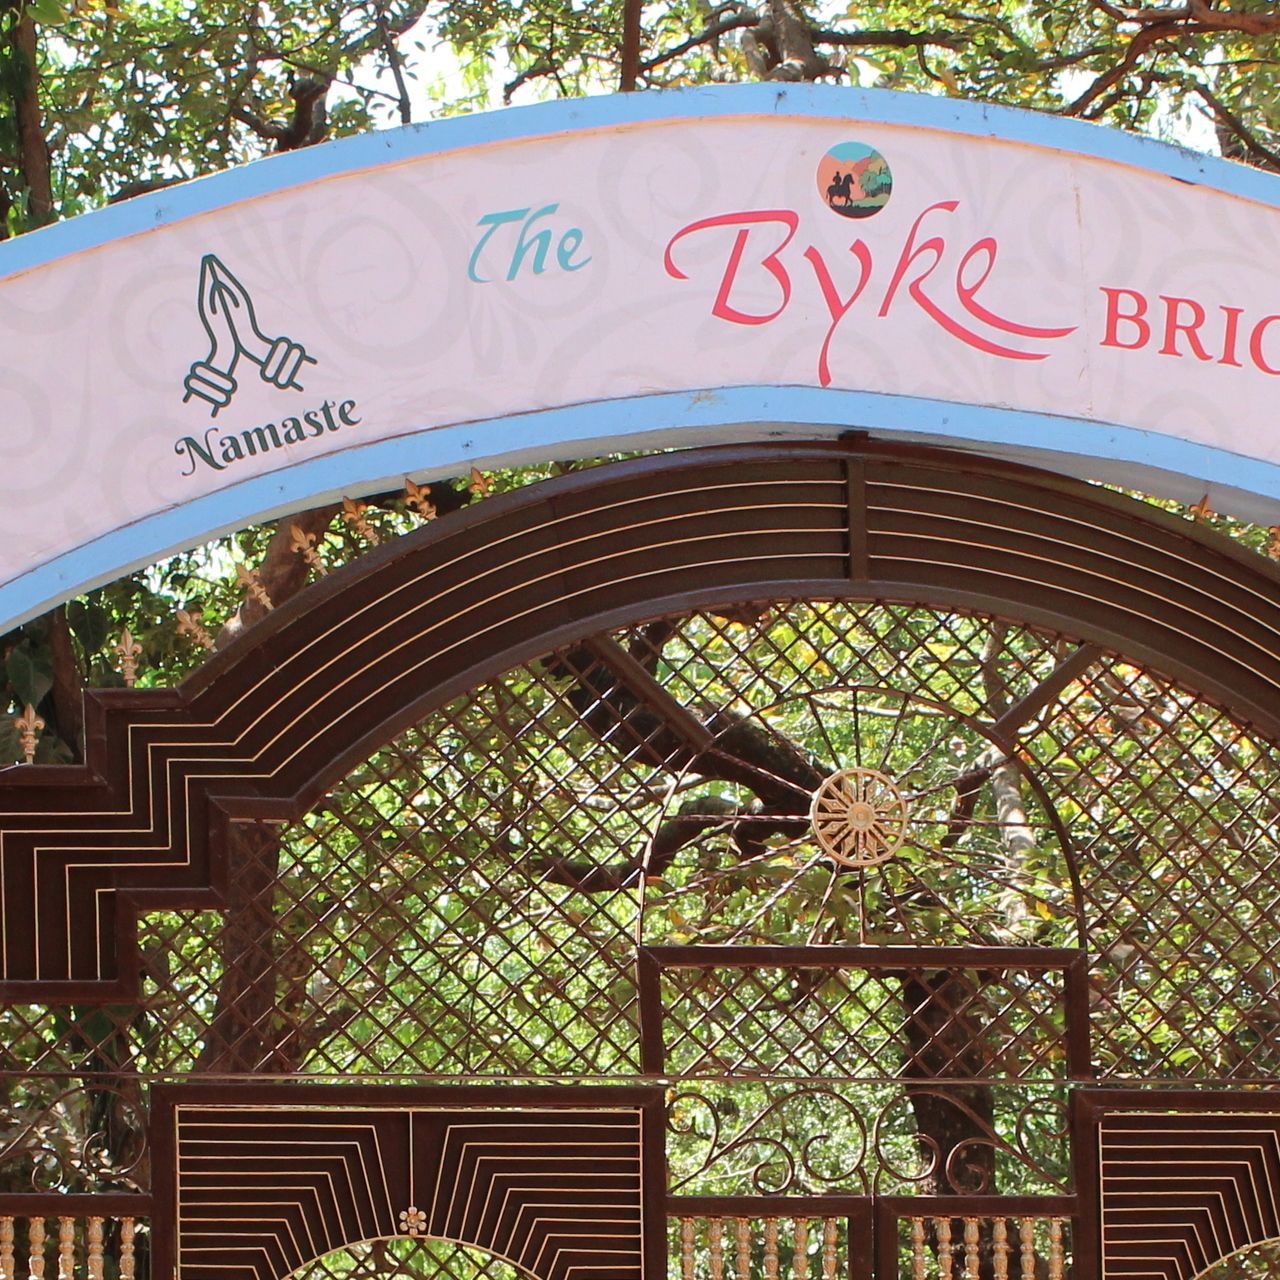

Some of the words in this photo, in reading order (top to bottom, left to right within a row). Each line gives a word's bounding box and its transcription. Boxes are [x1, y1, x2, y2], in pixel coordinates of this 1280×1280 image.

[467, 202, 593, 283] The
[663, 199, 1079, 388] Byke
[174, 399, 363, 477] Namaste
